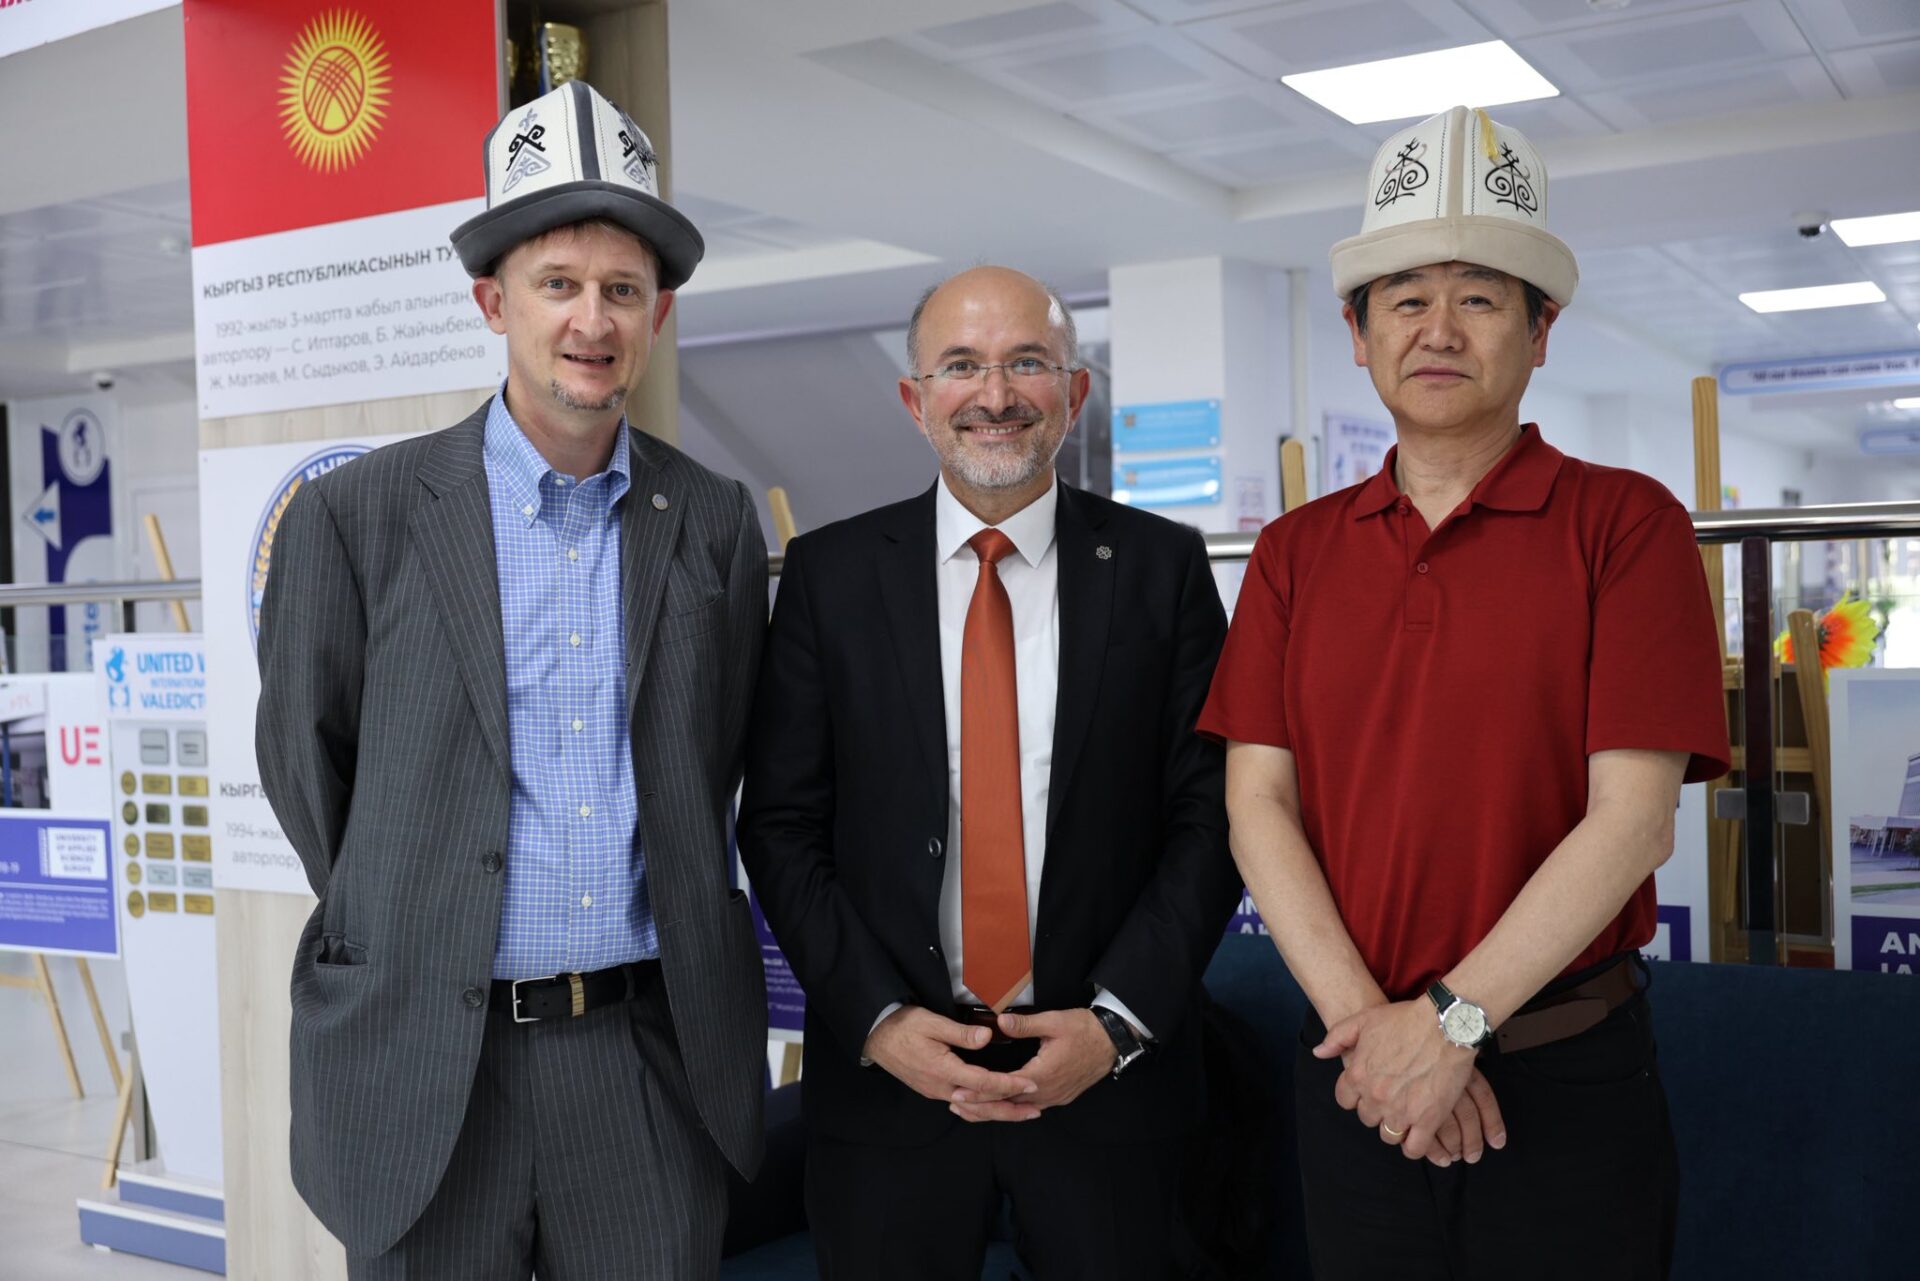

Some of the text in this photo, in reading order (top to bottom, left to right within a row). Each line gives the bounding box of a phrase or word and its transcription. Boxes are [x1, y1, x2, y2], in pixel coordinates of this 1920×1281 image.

[203, 246, 460, 299] КЫРГЫЗ РЕСПУБЛИКАСЫНЫН ТУ
[215, 317, 287, 338] 1992-жылы
[290, 307, 352, 328] 3-мартта
[355, 297, 401, 318] кабыл
[393, 316, 487, 339] Жайчыбеко
[390, 344, 486, 368] Айдарбеков
[137, 652, 194, 673] UNITED
[59, 726, 102, 766] UE
